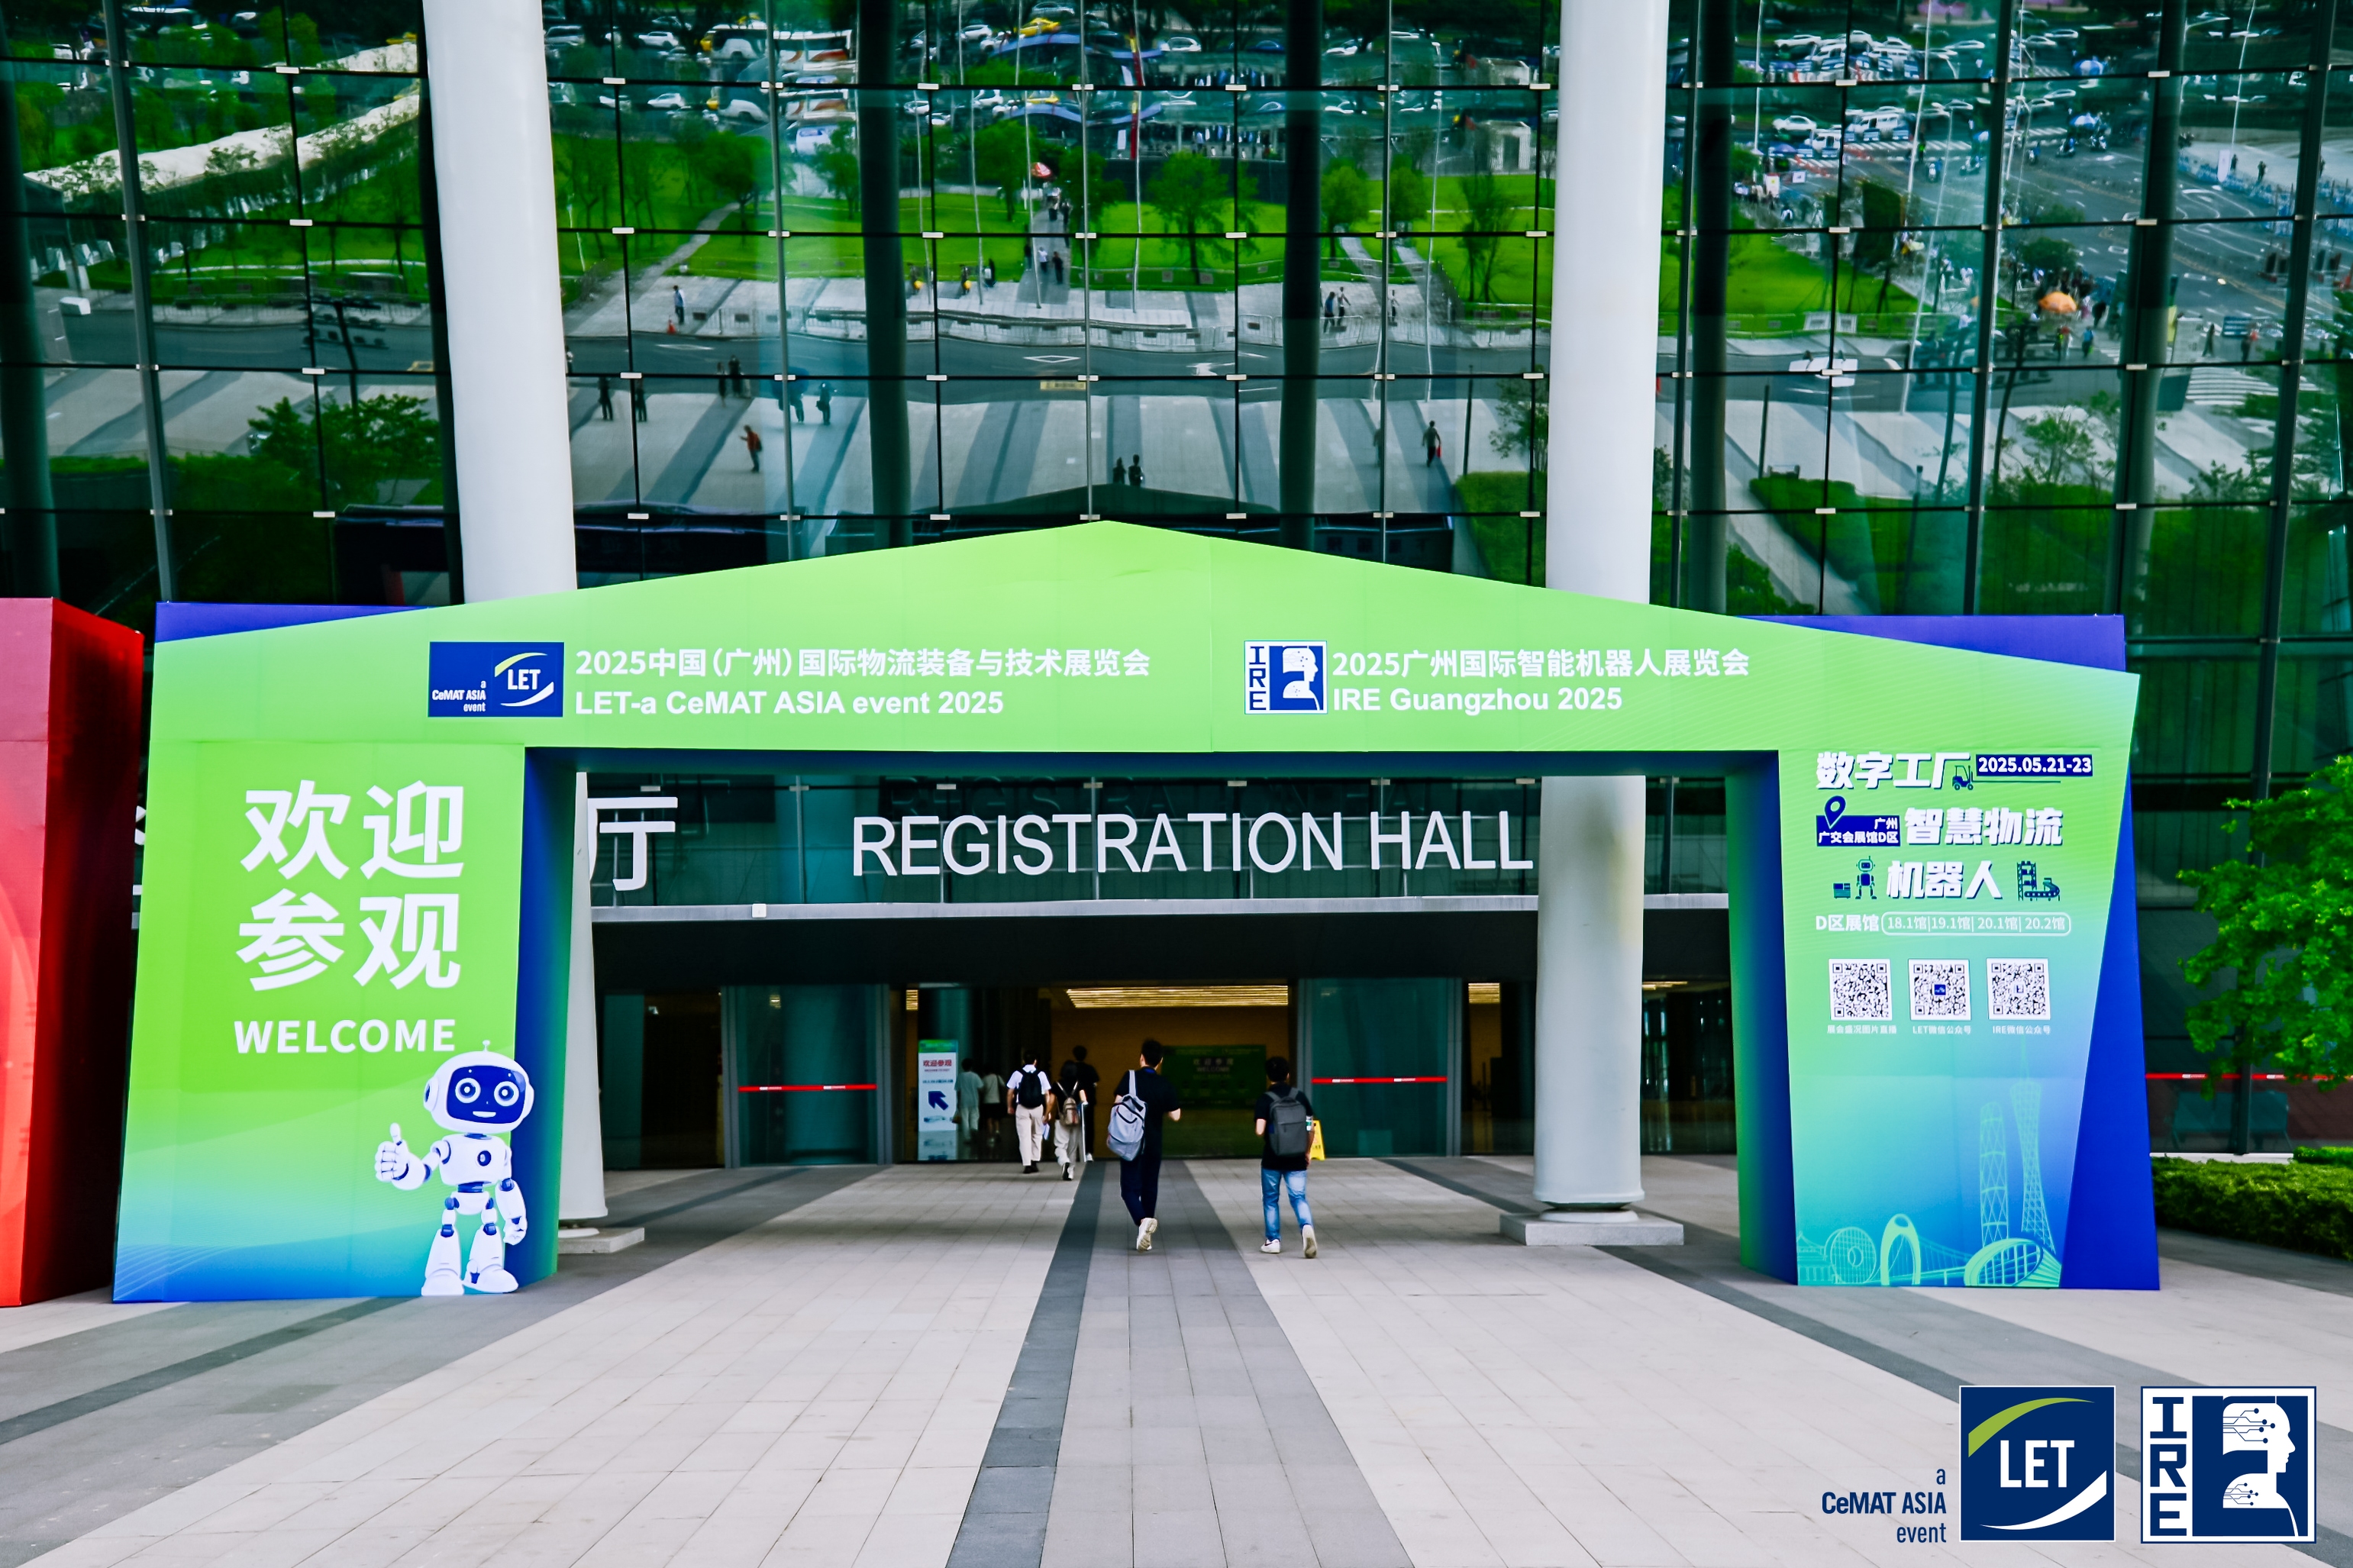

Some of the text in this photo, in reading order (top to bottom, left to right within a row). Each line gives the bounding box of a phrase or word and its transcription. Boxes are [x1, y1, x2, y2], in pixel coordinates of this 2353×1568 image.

[1332, 647, 1750, 678] 2025广州国际智能机器人展览会
[480, 680, 487, 689] a
[507, 669, 541, 690] LET
[1249, 646, 1267, 711] IRE
[431, 689, 486, 701] CeMAT ASIA
[463, 702, 486, 713] event
[576, 691, 1004, 715] LET-a CeMAT ASIA event 2025
[1334, 687, 1622, 716] IRE Guangzhou 2025
[1816, 751, 1971, 789] 数字工厂
[1978, 757, 2092, 773] 2025.05.21-23
[240, 779, 464, 880] 欢迎
[1818, 831, 1899, 844] 广交会展馆D区
[1874, 817, 1898, 831] 广州
[1904, 807, 2063, 845] 智慧物流
[853, 809, 1534, 878] REGISTRATION HALL
[1886, 860, 2002, 899] 机器人
[1816, 914, 1880, 932] D区展馆
[236, 888, 461, 992] 参观
[233, 1018, 456, 1054] WELCOME
